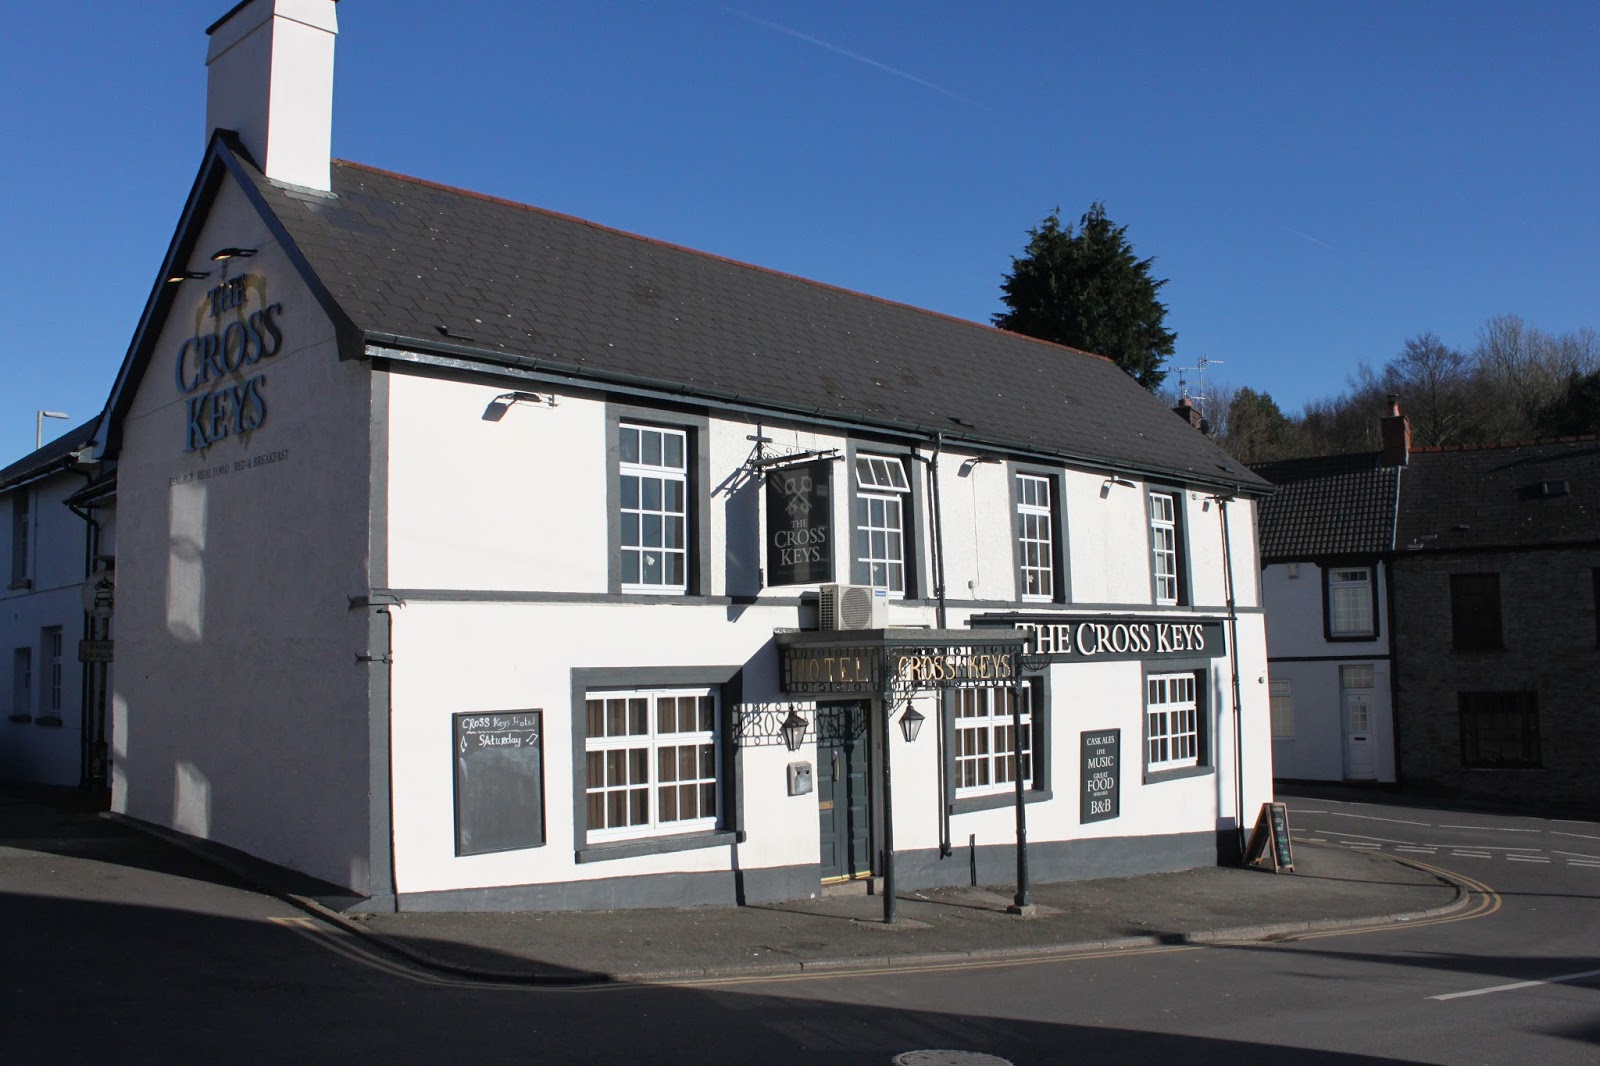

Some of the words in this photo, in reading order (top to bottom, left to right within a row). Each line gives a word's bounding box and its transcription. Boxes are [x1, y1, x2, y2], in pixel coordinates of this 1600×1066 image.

[207, 273, 247, 317] THE
[175, 303, 283, 394] CROSS
[183, 374, 267, 453] KEYS
[197, 468, 212, 481] REAL
[213, 464, 230, 477] FOOD
[234, 460, 247, 472] BED
[253, 449, 289, 468] BREAKFAST
[791, 519, 808, 529] THE
[774, 527, 826, 549] CROSS
[780, 546, 821, 566] KEYS
[1015, 622, 1072, 656] THE
[1076, 622, 1151, 656] CROSS
[1155, 623, 1205, 653] KEYS
[792, 657, 869, 683] HOTEL
[898, 655, 957, 682] CROSS
[968, 654, 1012, 680] KEYS
[1086, 736, 1102, 746] CASK
[1102, 735, 1115, 744] ALES
[1087, 756, 1114, 769] MUSIC
[1087, 777, 1114, 792] FOOD
[1093, 771, 1108, 780] GREAT
[1090, 798, 1111, 814] B&B
